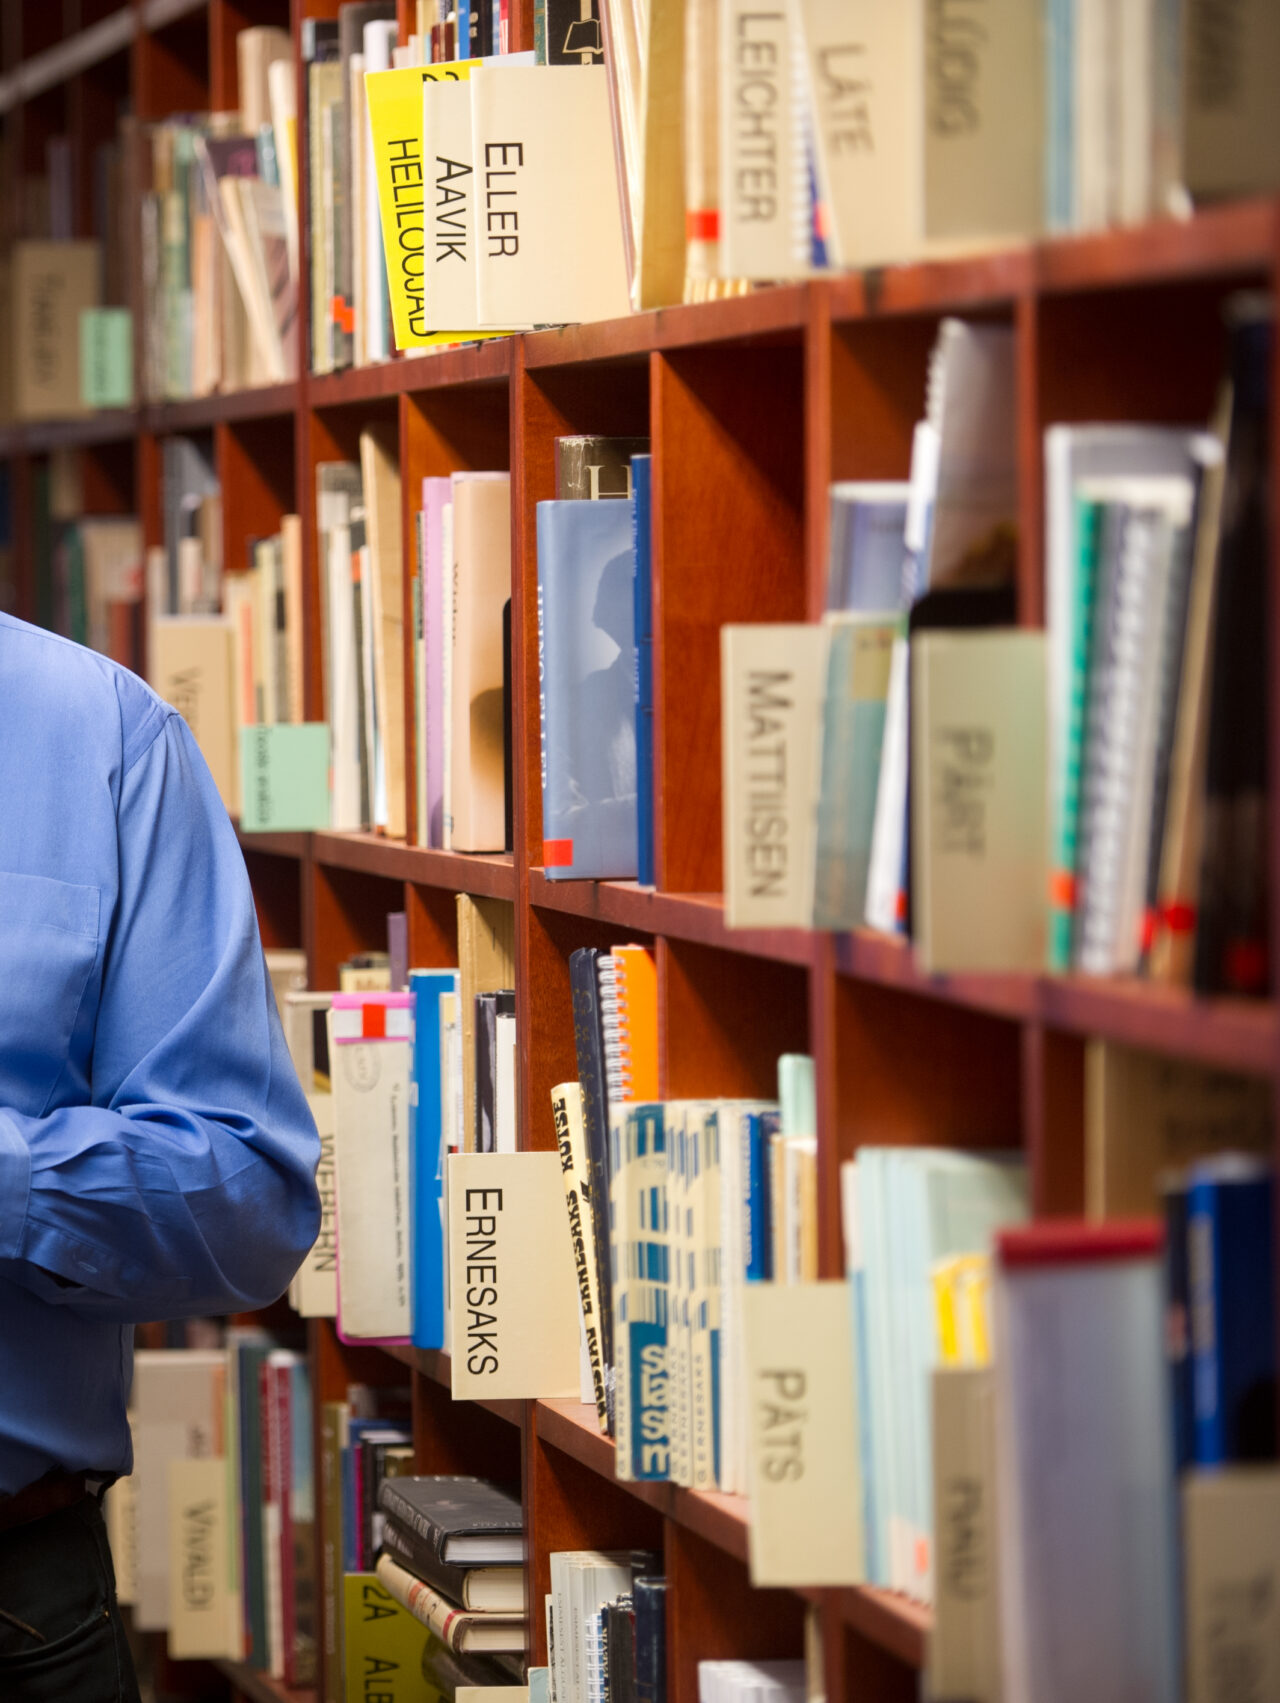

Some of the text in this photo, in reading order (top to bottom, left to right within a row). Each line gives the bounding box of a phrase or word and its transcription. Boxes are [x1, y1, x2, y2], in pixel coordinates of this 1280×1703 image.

[735, 12, 783, 224] LEICHTER
[387, 137, 438, 338] HELILOOJAD
[435, 156, 473, 263] AAVIK
[484, 142, 523, 258] ELLER
[746, 670, 795, 898] MATTIISEN
[553, 1097, 574, 1174] KUTSE
[465, 1187, 504, 1376] ERNESAKS
[759, 1368, 806, 1484] PÄTS
[362, 1583, 396, 1623] 2A
